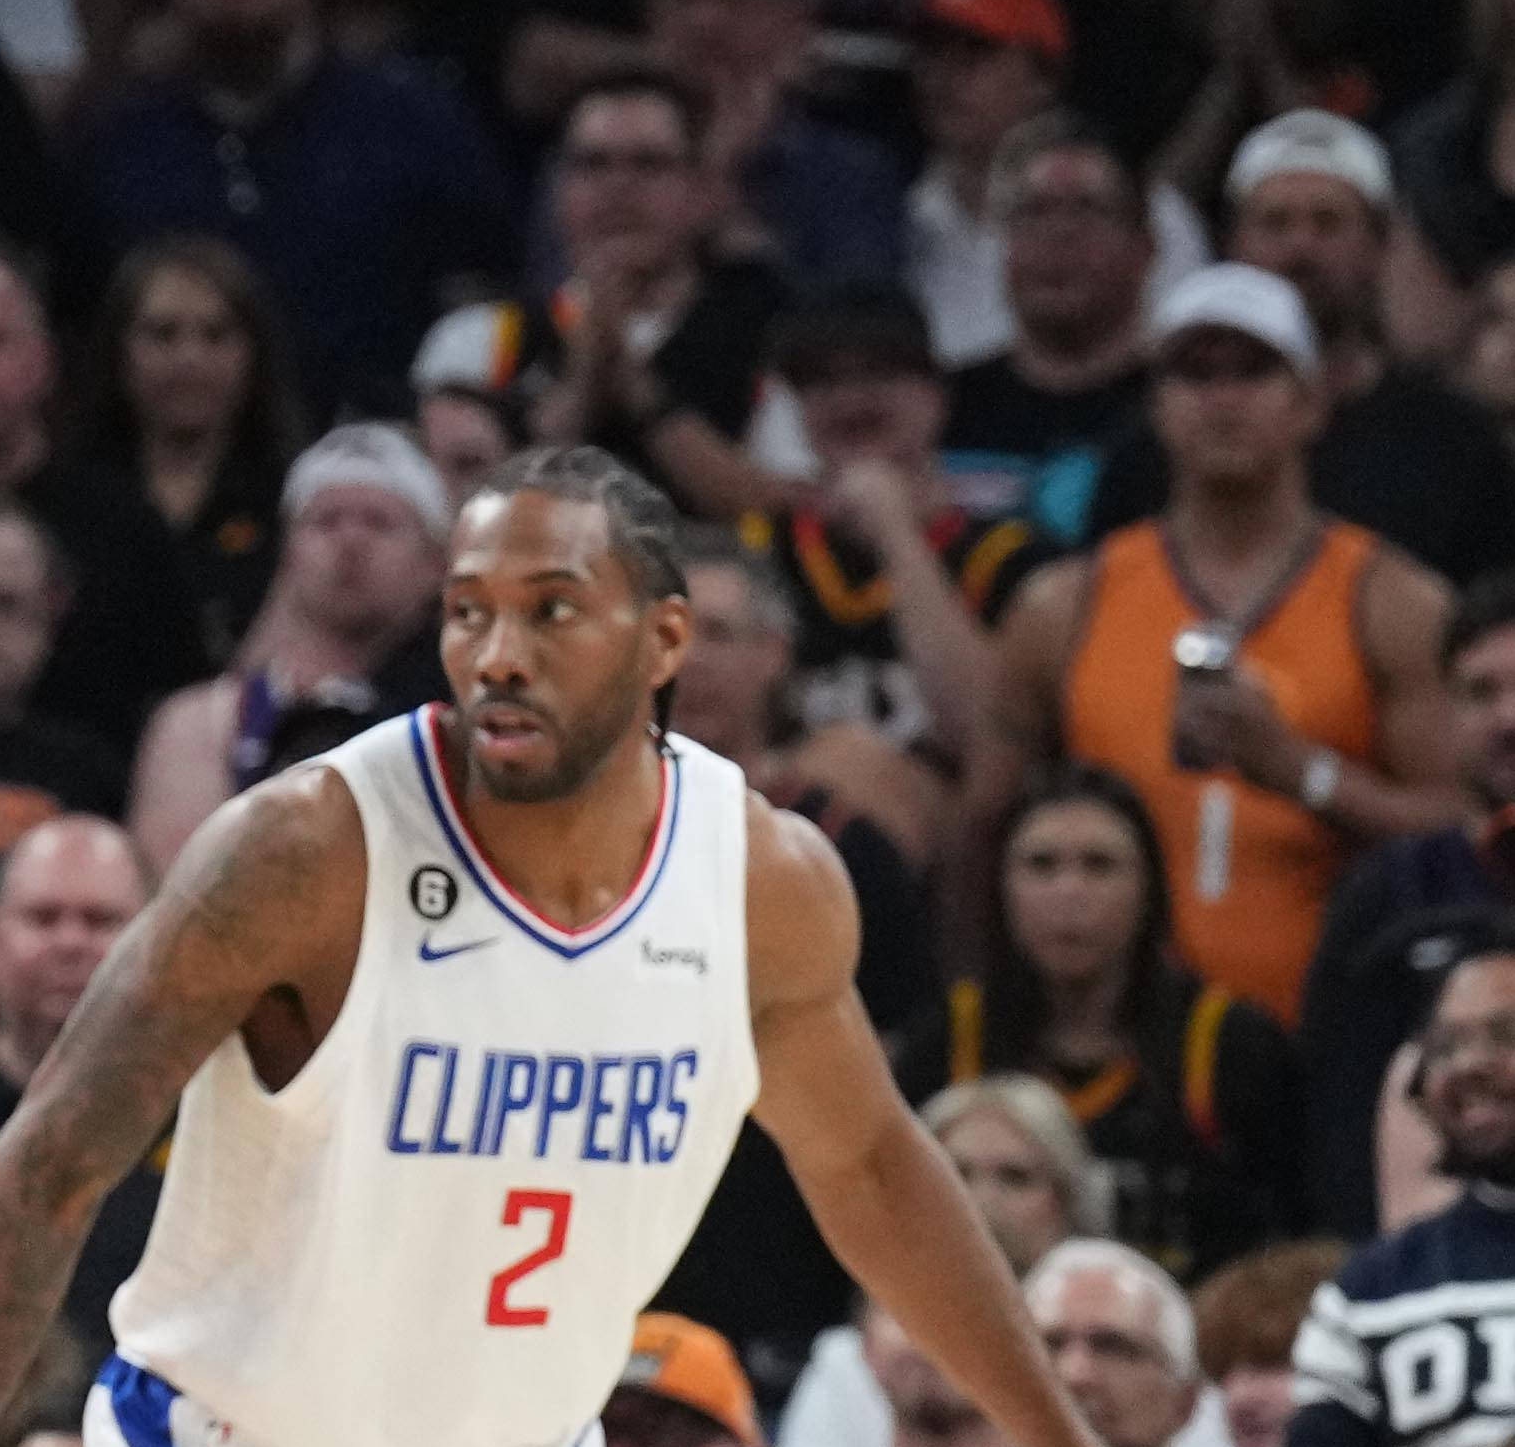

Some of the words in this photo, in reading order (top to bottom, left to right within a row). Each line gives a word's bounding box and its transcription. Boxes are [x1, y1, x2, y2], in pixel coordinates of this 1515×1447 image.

[416, 870, 449, 915] 6
[386, 1040, 698, 1164] CLIPPERS
[484, 1188, 573, 1327] 2
